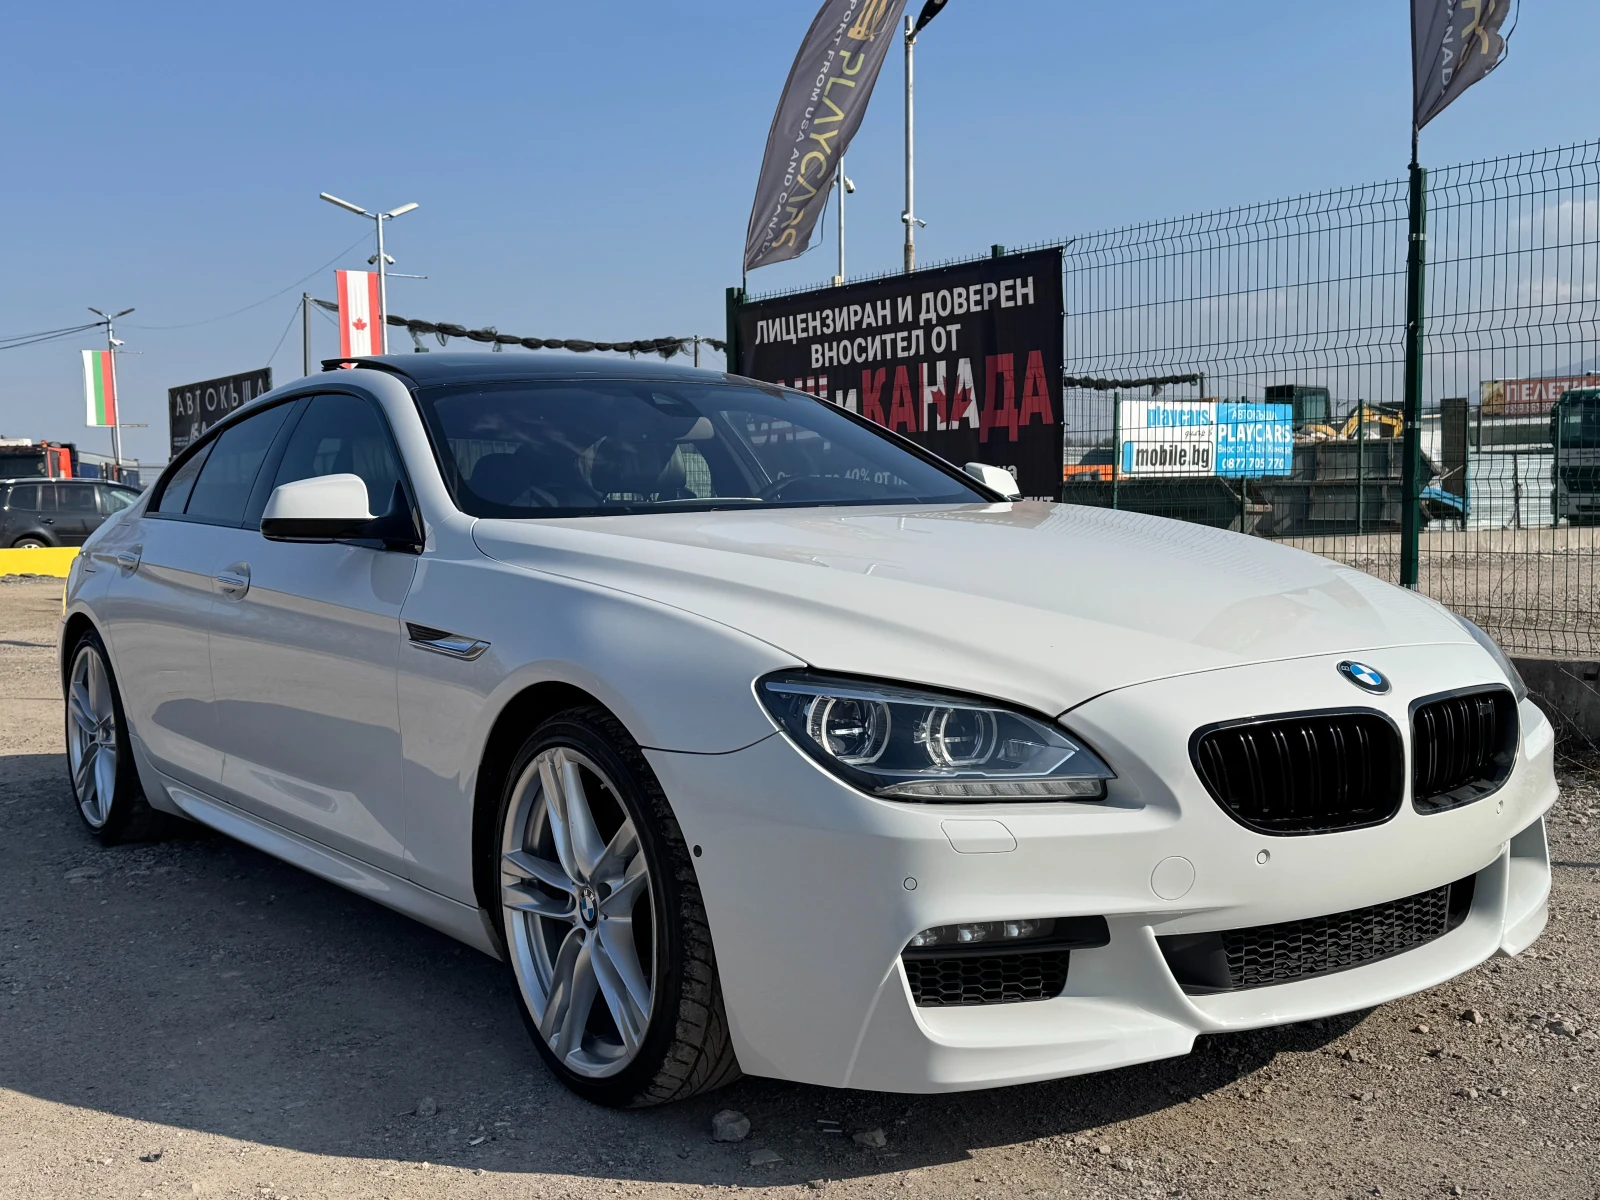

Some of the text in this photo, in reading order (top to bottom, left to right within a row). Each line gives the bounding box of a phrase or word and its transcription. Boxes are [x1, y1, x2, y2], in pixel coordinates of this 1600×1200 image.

[810, 50, 835, 102] FROM
[795, 106, 815, 142] USA
[771, 50, 866, 248] PLAYCARS
[783, 147, 800, 187] AND
[754, 275, 1036, 345] ЛИЦЕНЗИРАН И ДОВЕРЕН
[811, 324, 962, 369] ВНОСИТЕЛ ОТ
[861, 350, 1055, 443] КАНАДА
[1217, 423, 1292, 443] PLAYCARS
[1217, 444, 1235, 453] Внос
[1135, 444, 1210, 469] mobile.bg
[1221, 458, 1285, 469] 0877 705 770
